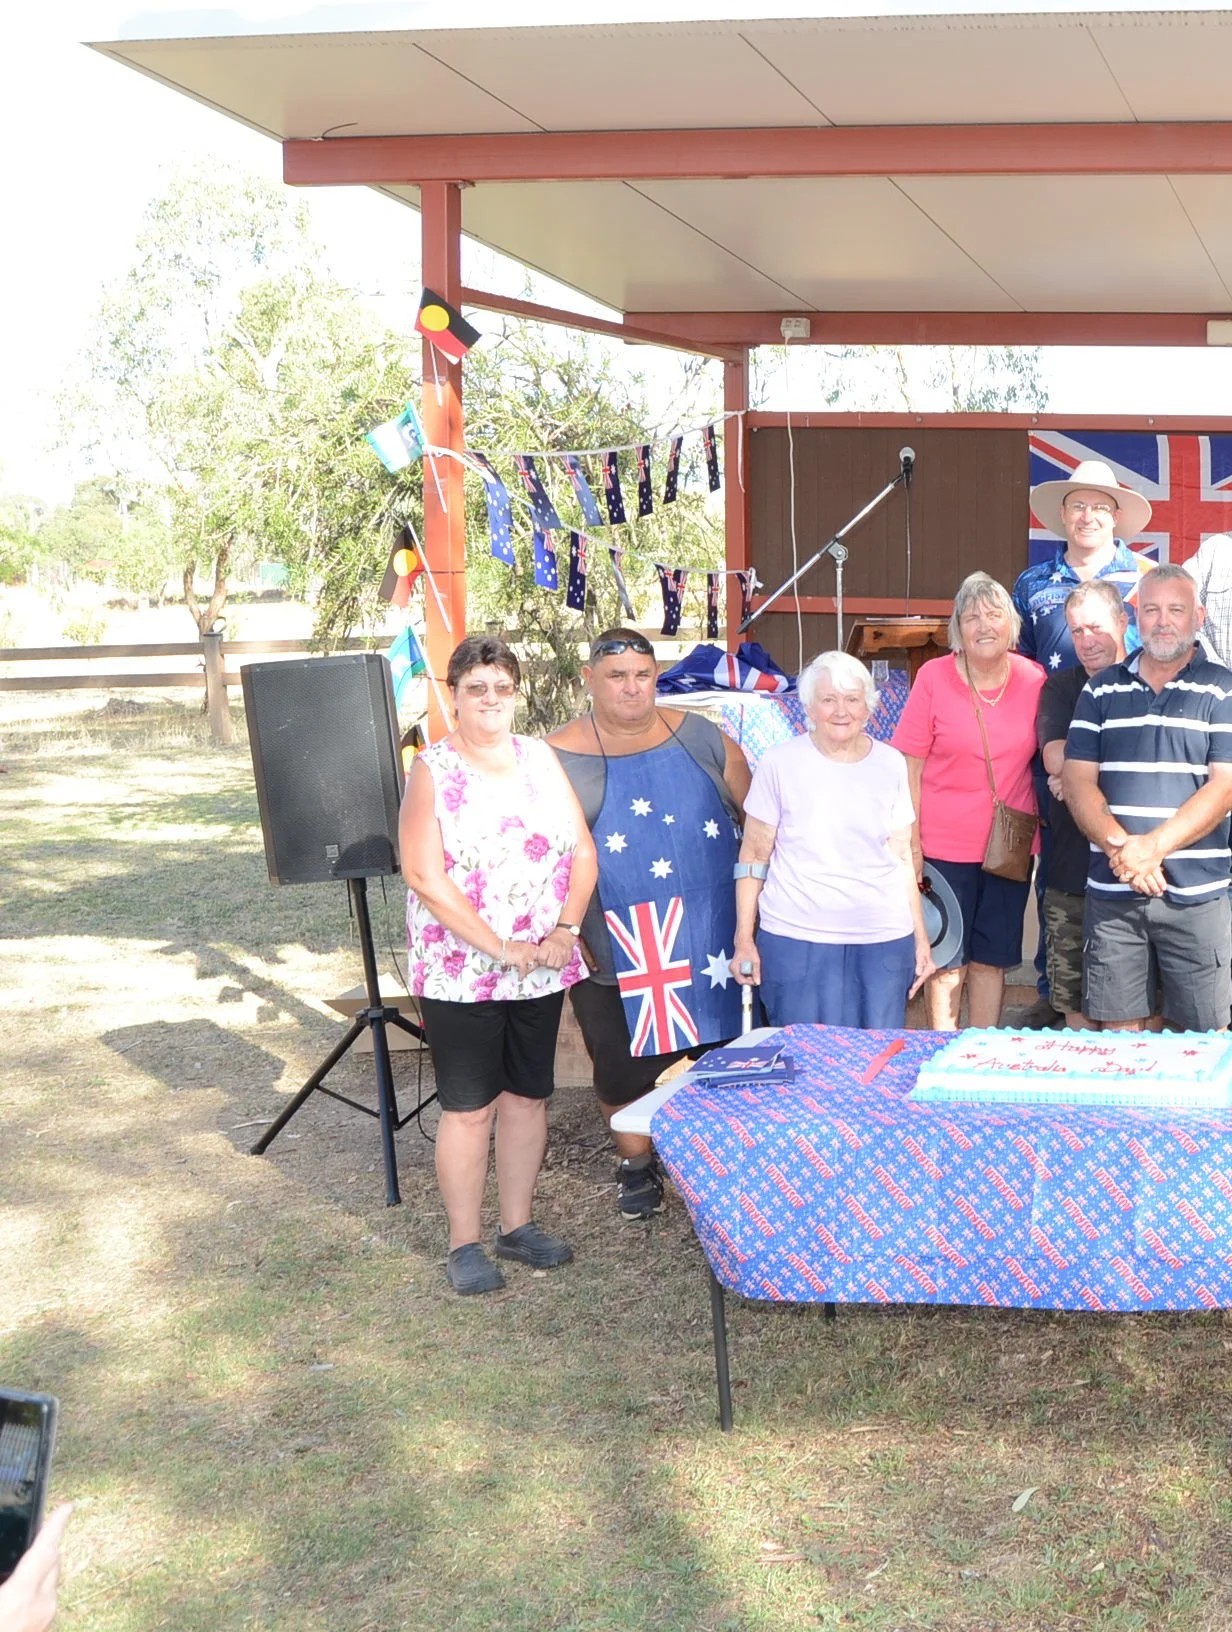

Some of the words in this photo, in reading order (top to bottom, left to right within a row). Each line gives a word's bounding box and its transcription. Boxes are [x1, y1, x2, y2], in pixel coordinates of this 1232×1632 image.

[1034, 1040, 1117, 1056] Happy
[689, 1133, 728, 1177] AUSTRALIA
[794, 1135, 835, 1179] AUSTRALIA
[902, 1136, 943, 1180] AUSTRALIA
[1013, 1135, 1052, 1181] AUSTRALIA
[1126, 1137, 1167, 1183] AUSTRALIA
[766, 1163, 805, 1208] AUSTRALIA
[872, 1165, 914, 1210] AUSTRALIA
[984, 1166, 1024, 1211] AUSTRALIA
[1093, 1167, 1134, 1212] AUSTRALIA
[738, 1192, 776, 1238] AUSTRALIA
[844, 1195, 884, 1240] AUSTRALIA
[953, 1195, 996, 1241] AUSTRALIA
[1060, 1196, 1099, 1240] AUSTRALIA
[1175, 1199, 1216, 1242] AUSTRALIA
[815, 1223, 852, 1264] AUSTRALIA
[924, 1225, 968, 1269] AUSTRALIA
[1030, 1225, 1069, 1270] AUSTRALIA
[1141, 1227, 1184, 1270] AUSTRALIA
[786, 1253, 826, 1294] AUSTRALIA
[895, 1255, 938, 1294] AUSTRALIA
[1004, 1256, 1042, 1299] AUSTRALIA
[1110, 1256, 1153, 1303] AUSTRALIA
